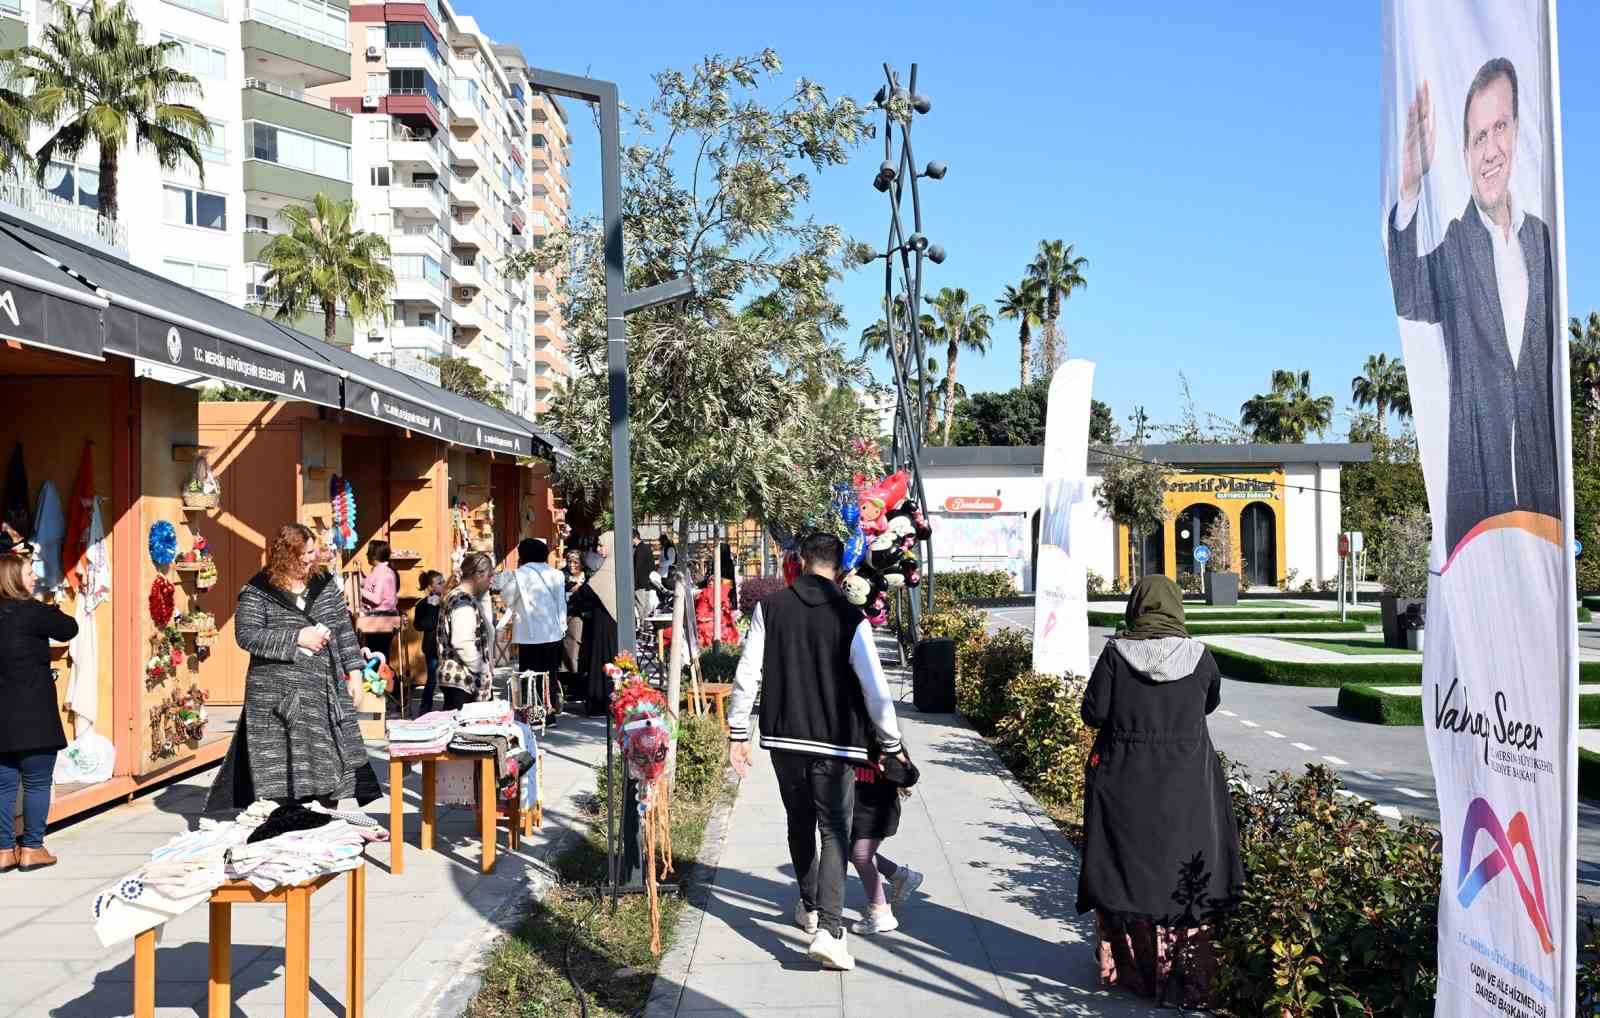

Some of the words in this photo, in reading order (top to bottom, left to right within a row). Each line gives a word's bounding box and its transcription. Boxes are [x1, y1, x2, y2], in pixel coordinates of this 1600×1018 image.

[1215, 478, 1277, 493] Market
[1435, 677, 1490, 766] Vahap
[1493, 690, 1543, 751] Seçer
[1487, 972, 1497, 987] VE
